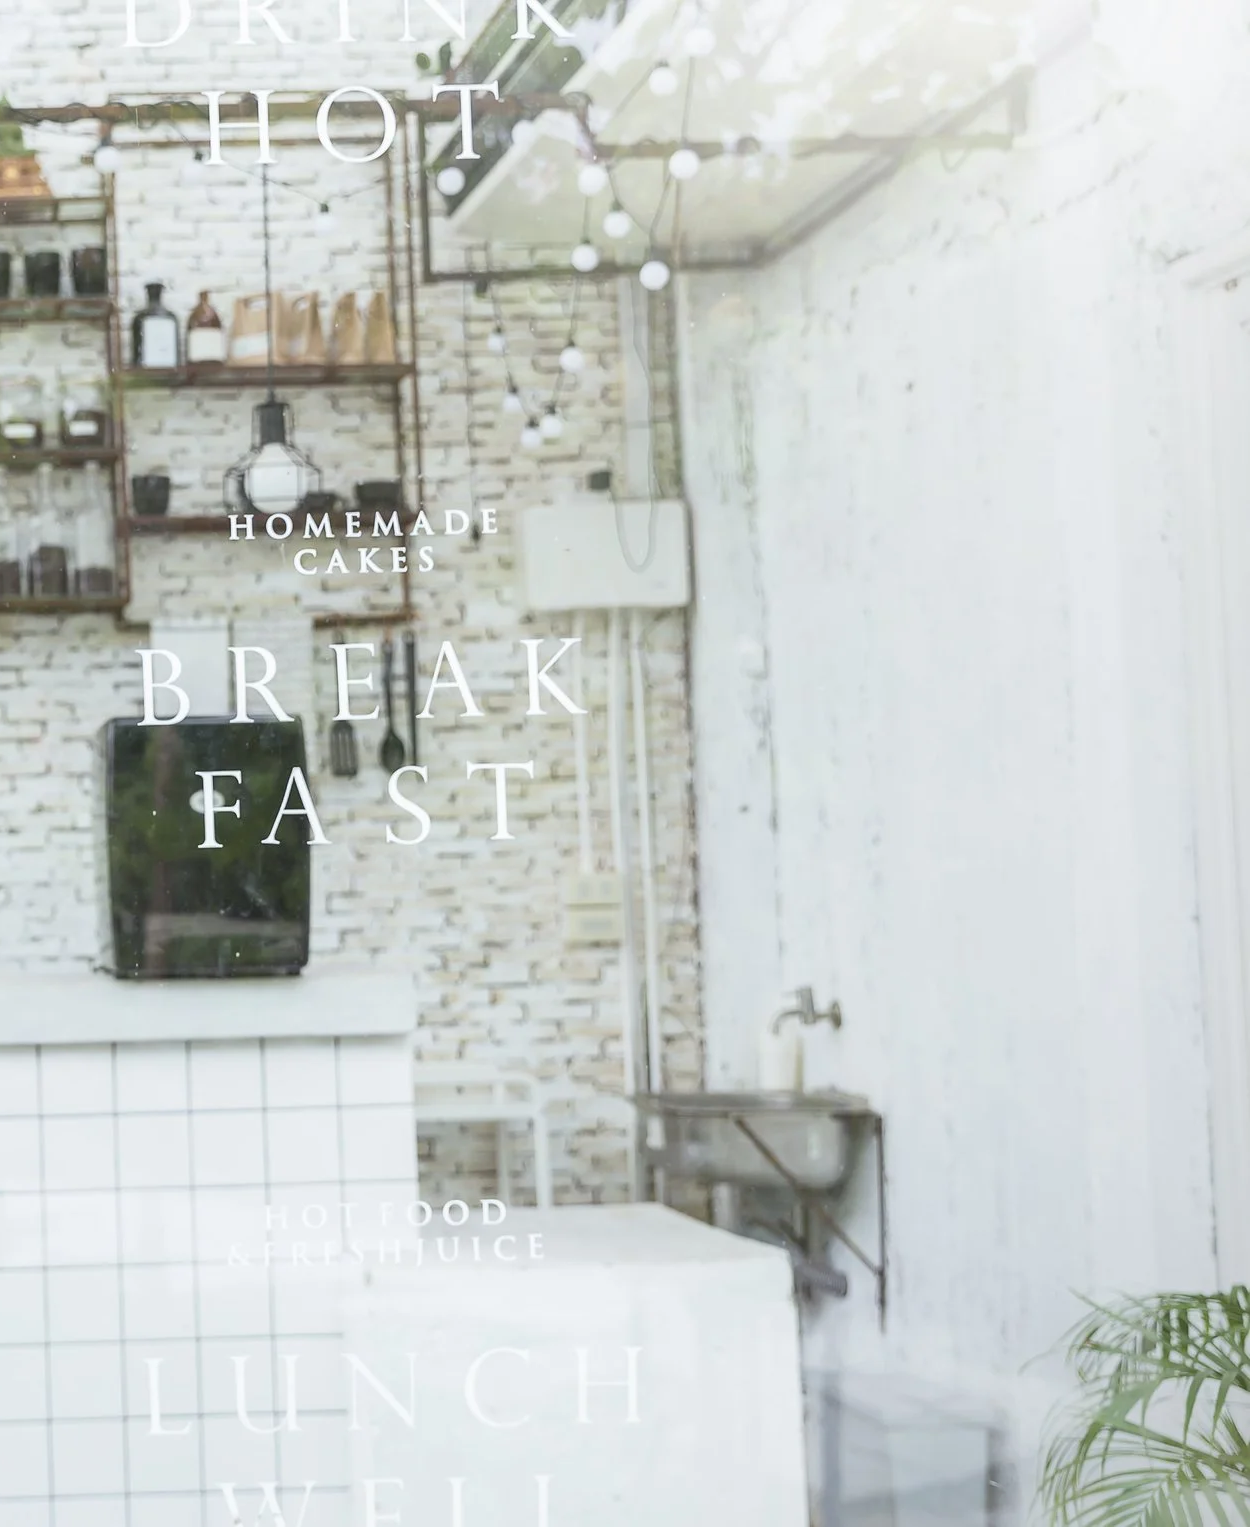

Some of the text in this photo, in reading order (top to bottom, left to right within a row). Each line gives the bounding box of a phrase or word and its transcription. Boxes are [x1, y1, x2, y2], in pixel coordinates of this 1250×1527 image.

[123, 0, 576, 48] DRINK
[200, 80, 500, 166] HOT
[228, 508, 499, 541] HOMEMADE
[293, 546, 436, 575] CAKES
[134, 637, 589, 727] BREAK
[194, 759, 535, 849] FAST
[264, 1198, 508, 1231] HOT FOOD
[141, 1345, 645, 1436] LUNCH
